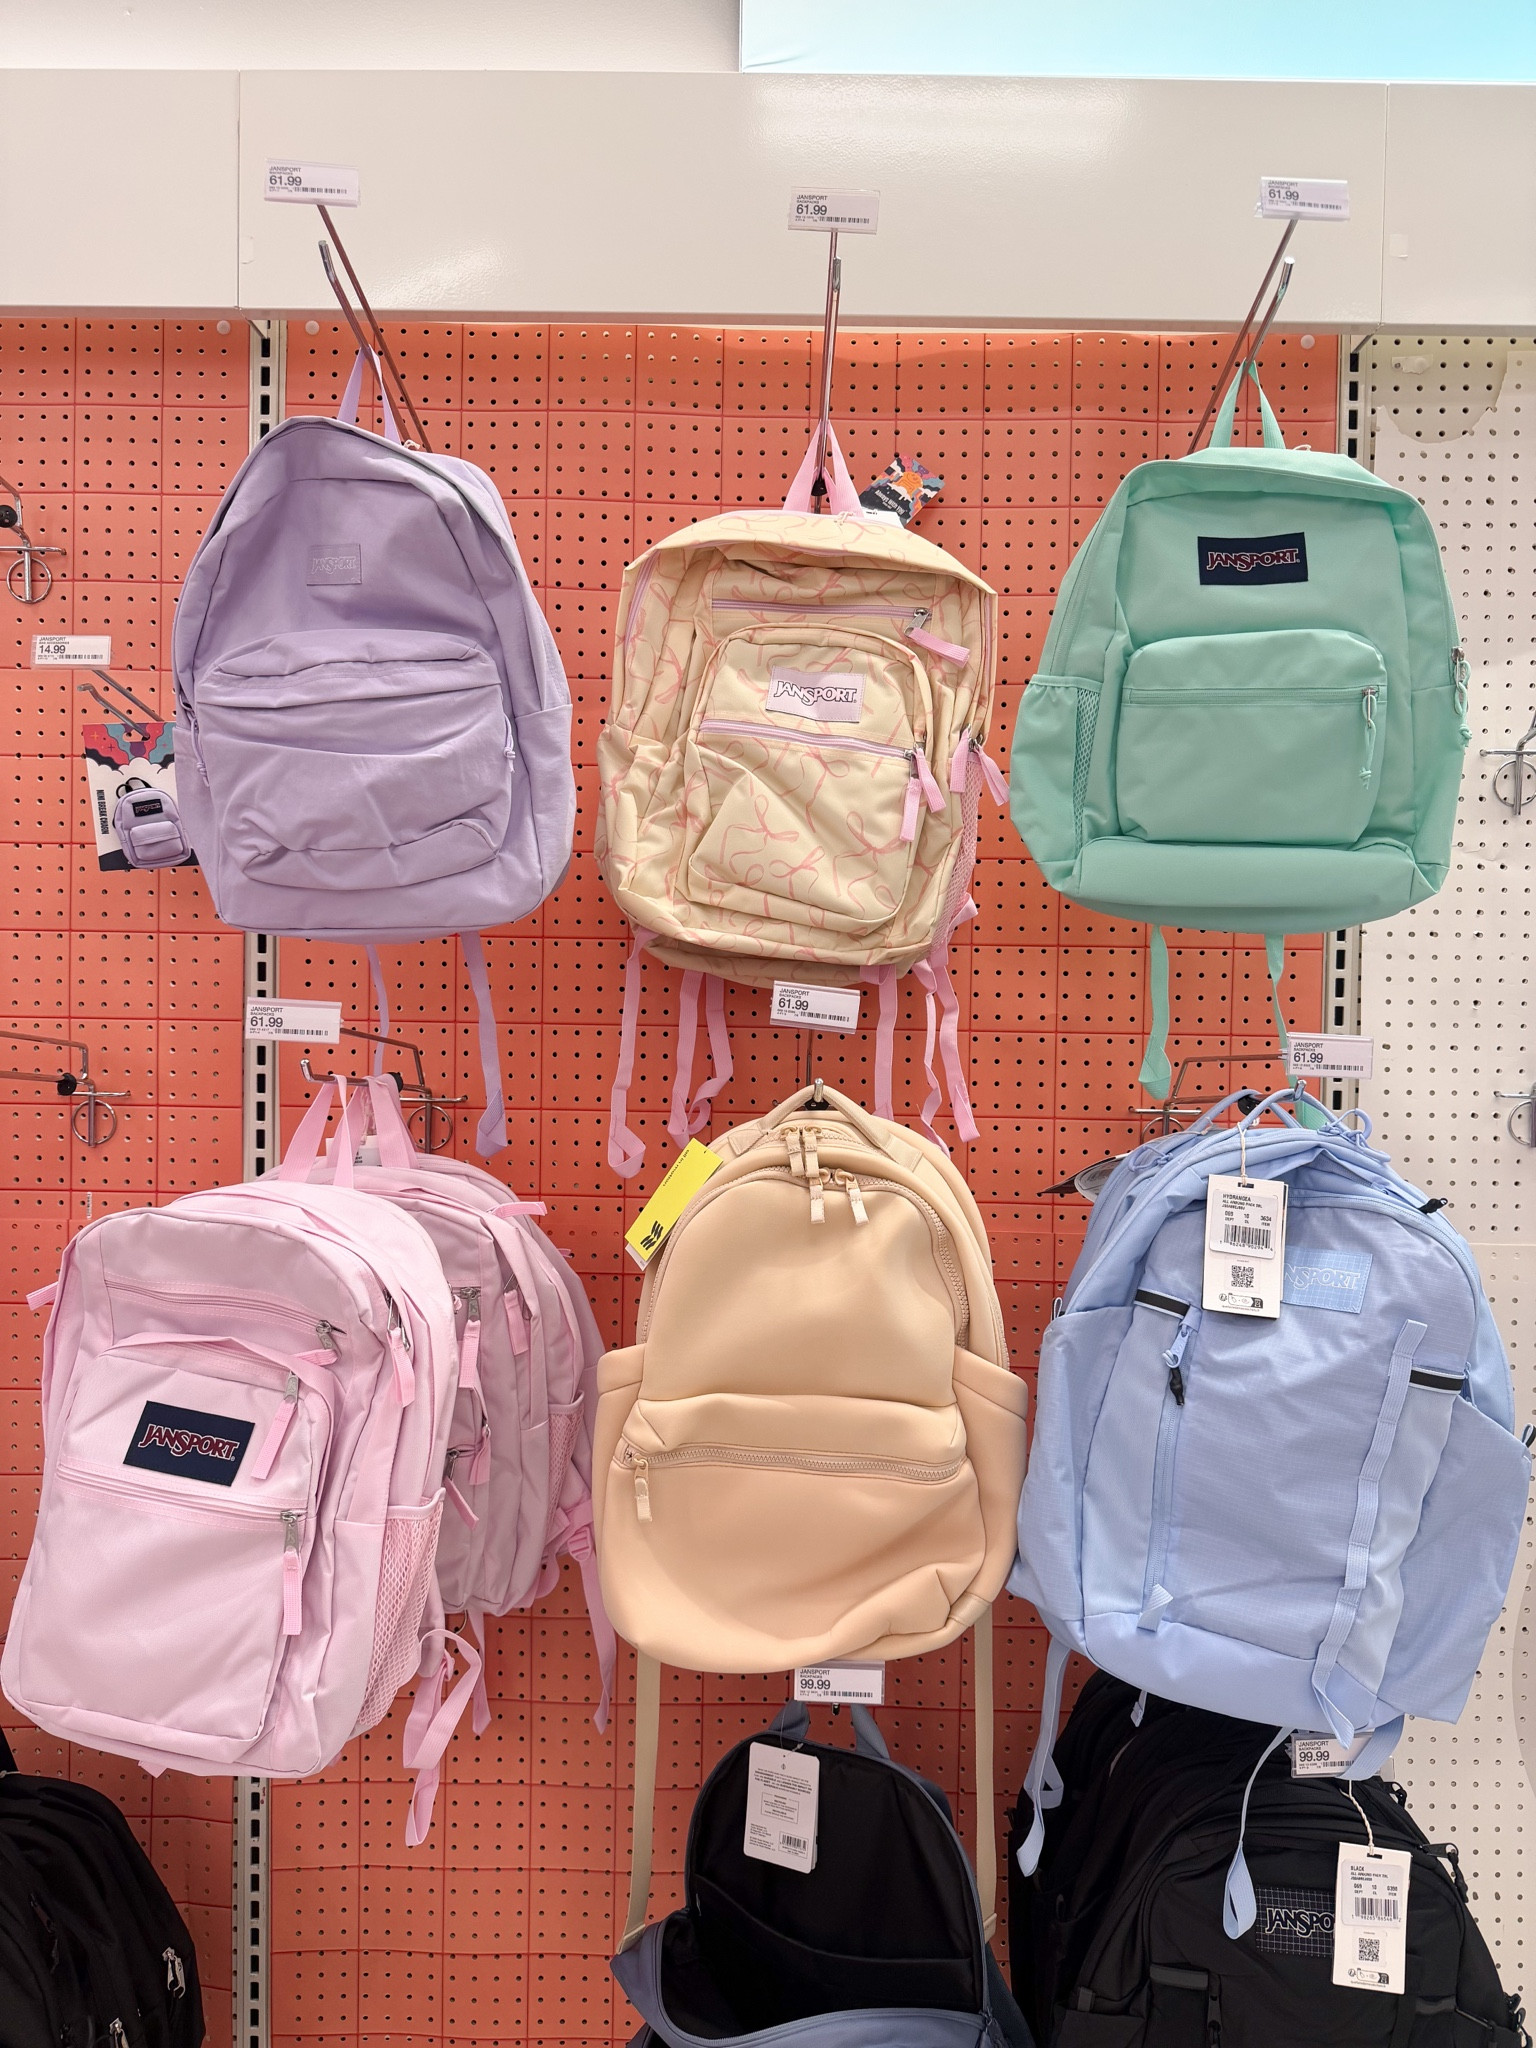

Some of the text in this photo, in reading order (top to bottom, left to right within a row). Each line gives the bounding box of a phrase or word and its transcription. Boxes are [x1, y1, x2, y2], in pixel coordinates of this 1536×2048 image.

[269, 175, 302, 186] 61.99
[1268, 189, 1299, 200] 61.99
[796, 204, 827, 215] 61.99
[311, 556, 356, 574] JANSPORT
[1206, 548, 1298, 572] JANSPORT
[40, 645, 66, 654] 14.99
[774, 681, 857, 706] JANSPORT
[778, 998, 808, 1010] 61.99
[250, 1016, 283, 1028] 61.99
[1294, 1052, 1323, 1063] 61.99
[1285, 1262, 1360, 1289] NSPORT
[138, 1423, 240, 1460] JANSPORT
[800, 1679, 830, 1689] 99.99
[1299, 1751, 1329, 1762] 99.99
[1265, 1908, 1335, 1937] JANSPO
